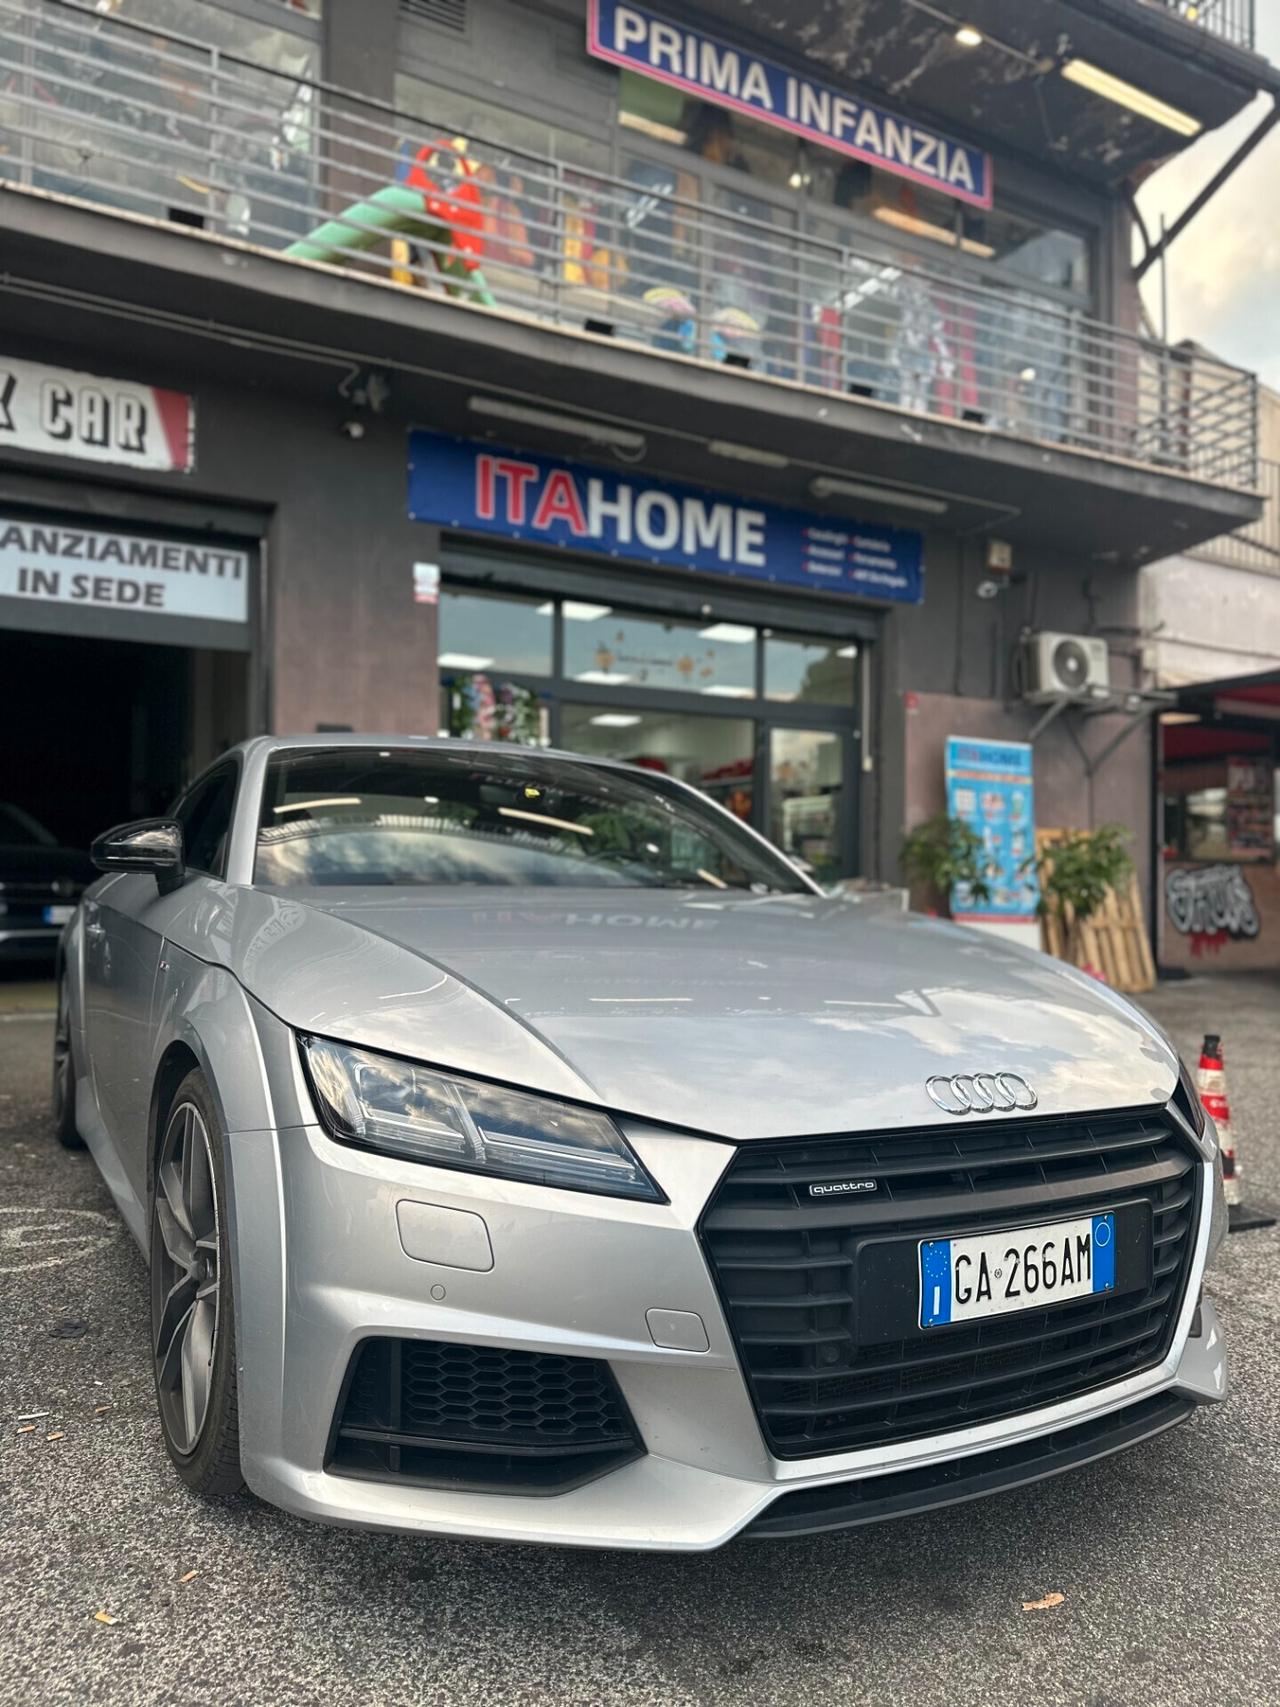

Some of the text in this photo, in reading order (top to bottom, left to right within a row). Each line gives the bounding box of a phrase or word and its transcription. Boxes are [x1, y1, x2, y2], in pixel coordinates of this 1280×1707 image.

[614, 6, 975, 190] PRIMA INFANZIA
[40, 378, 147, 454] CAR
[476, 454, 766, 567] ITAHOME
[0, 526, 242, 580] ANZIAMENTI
[18, 568, 165, 607] IN SEDE
[813, 1182, 875, 1194] quattro
[955, 1233, 1092, 1304] GA 266AM
